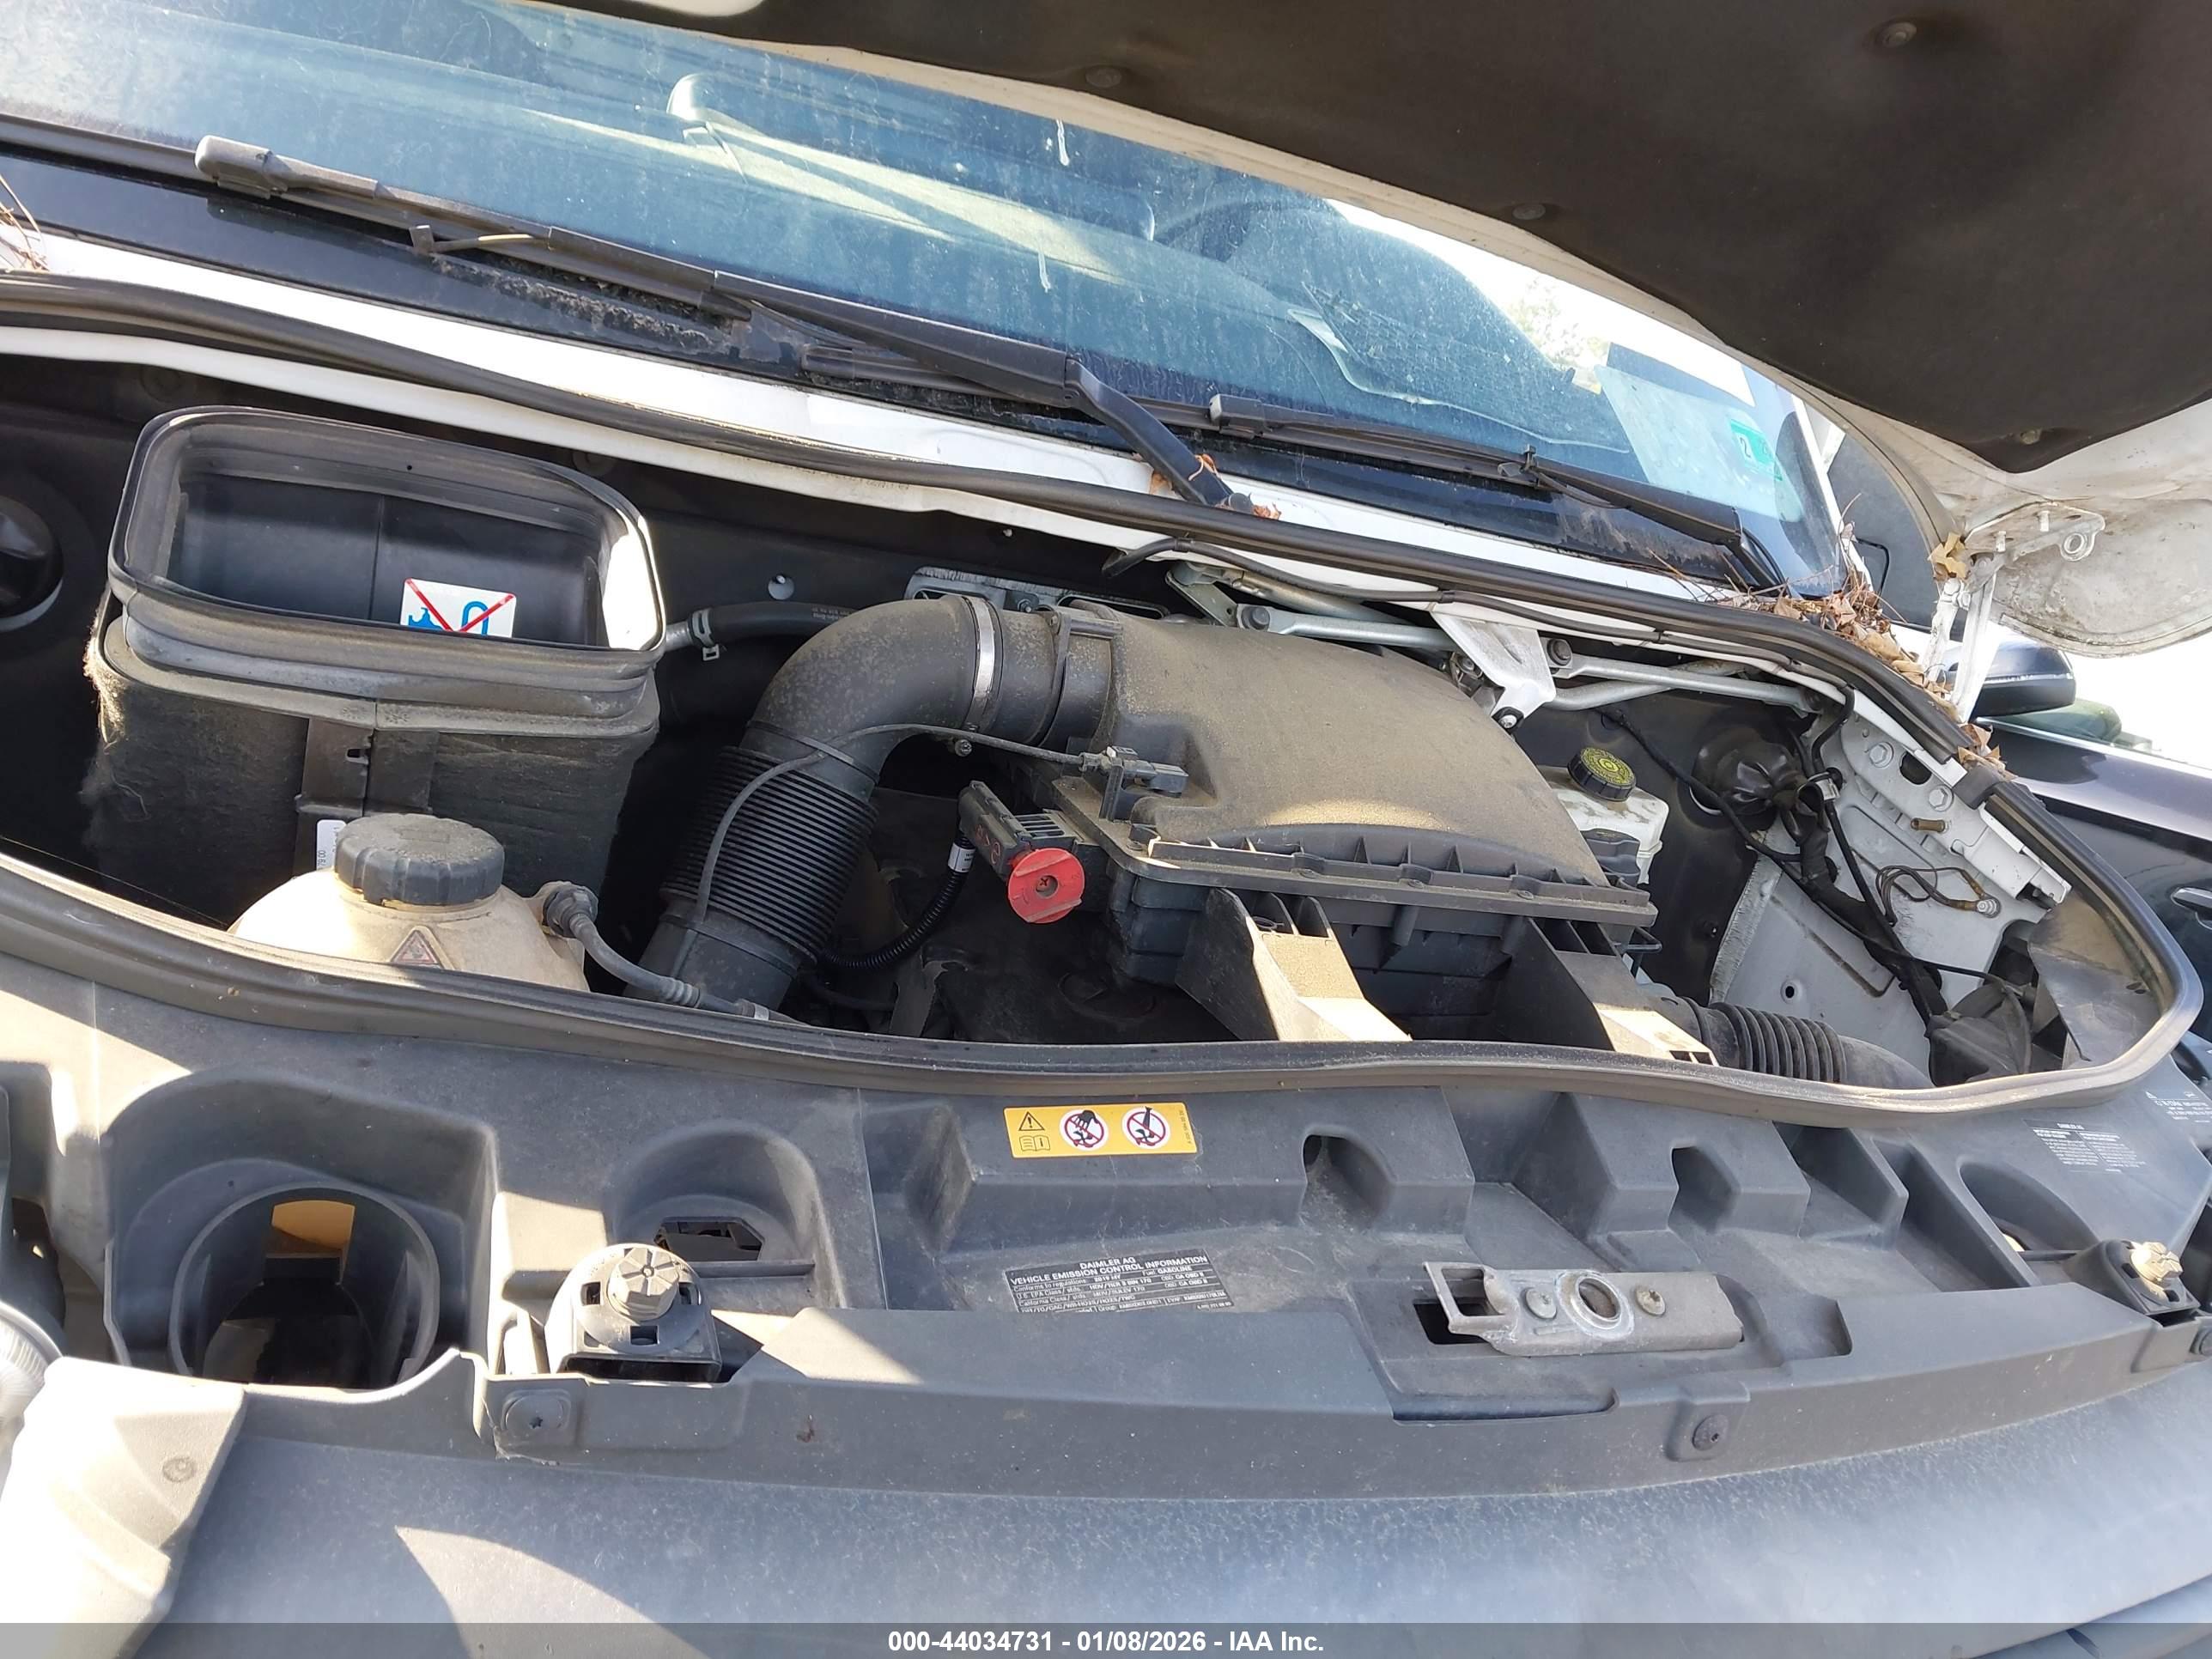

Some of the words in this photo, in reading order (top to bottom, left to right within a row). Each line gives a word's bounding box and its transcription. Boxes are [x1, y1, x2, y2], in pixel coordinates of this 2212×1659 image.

[1010, 1273, 1052, 1285] VEHICLE
[1052, 1268, 1098, 1280] EMISSION
[1099, 1262, 1144, 1276] CONTROL
[1145, 1255, 1208, 1269] INFORMATION
[1079, 1258, 1121, 1270] DAIMLER
[1122, 1256, 1136, 1265] AG
